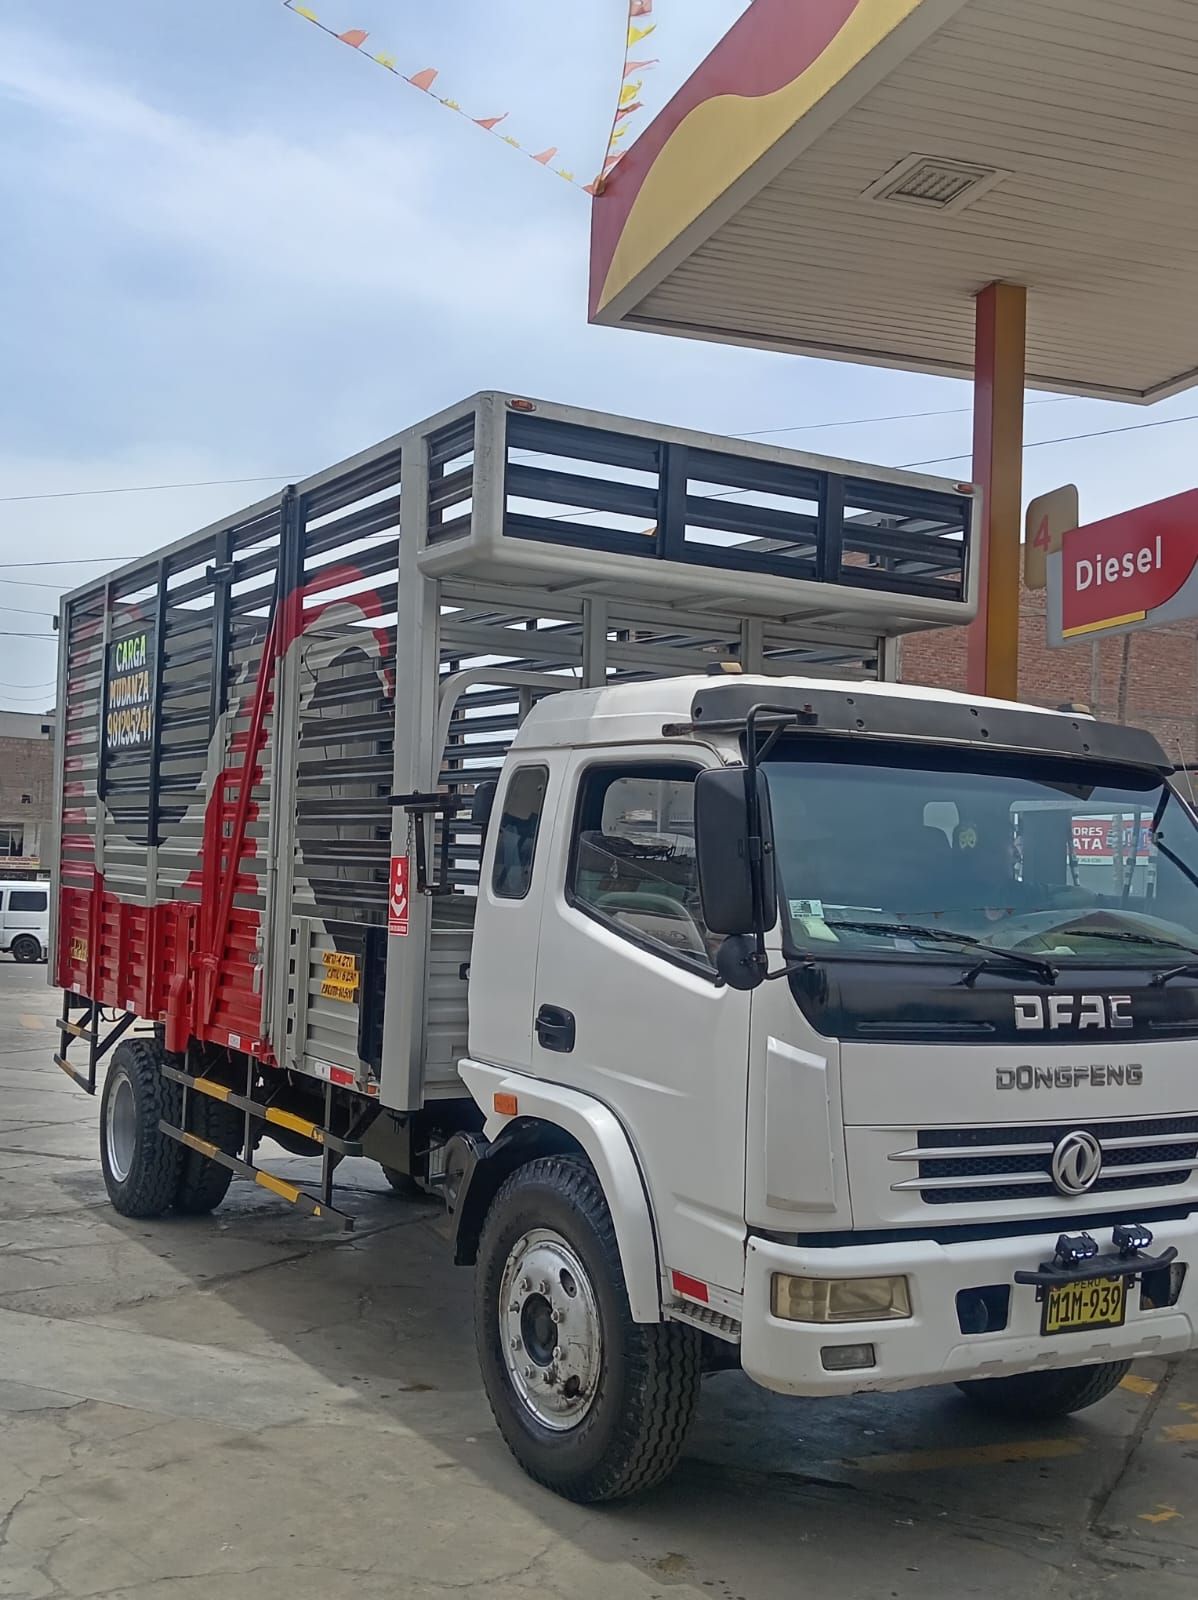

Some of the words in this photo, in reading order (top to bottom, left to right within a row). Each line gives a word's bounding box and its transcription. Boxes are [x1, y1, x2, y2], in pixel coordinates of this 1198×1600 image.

[1033, 514, 1051, 549] 4
[1076, 535, 1162, 592] Diesel
[116, 635, 146, 672] CARGA
[109, 670, 149, 709] MUDANZA
[1013, 995, 1134, 1030] DFAC
[996, 1064, 1143, 1090] DONGFENG
[1048, 1285, 1121, 1324] M1M-939
